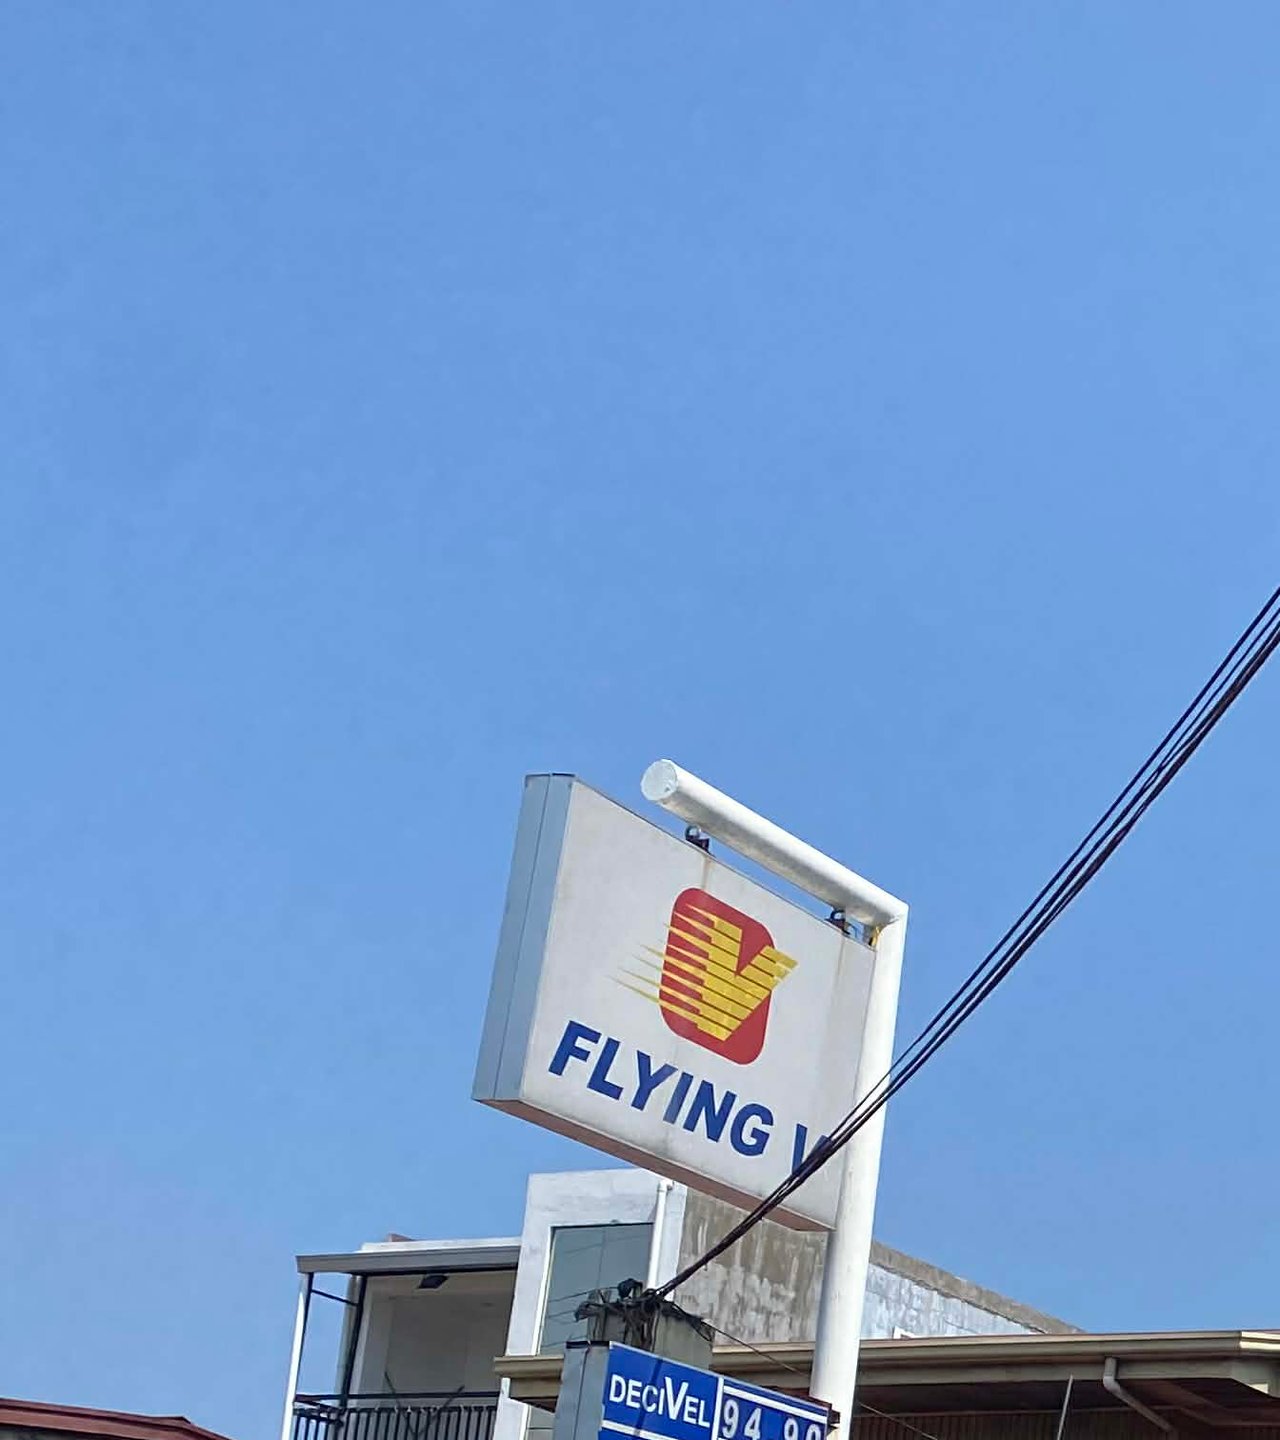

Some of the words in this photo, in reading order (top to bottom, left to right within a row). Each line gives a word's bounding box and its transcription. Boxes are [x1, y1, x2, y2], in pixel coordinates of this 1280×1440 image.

[548, 1020, 774, 1156] FLYING
[792, 1122, 832, 1180] V
[609, 1374, 710, 1428] DECIVEL
